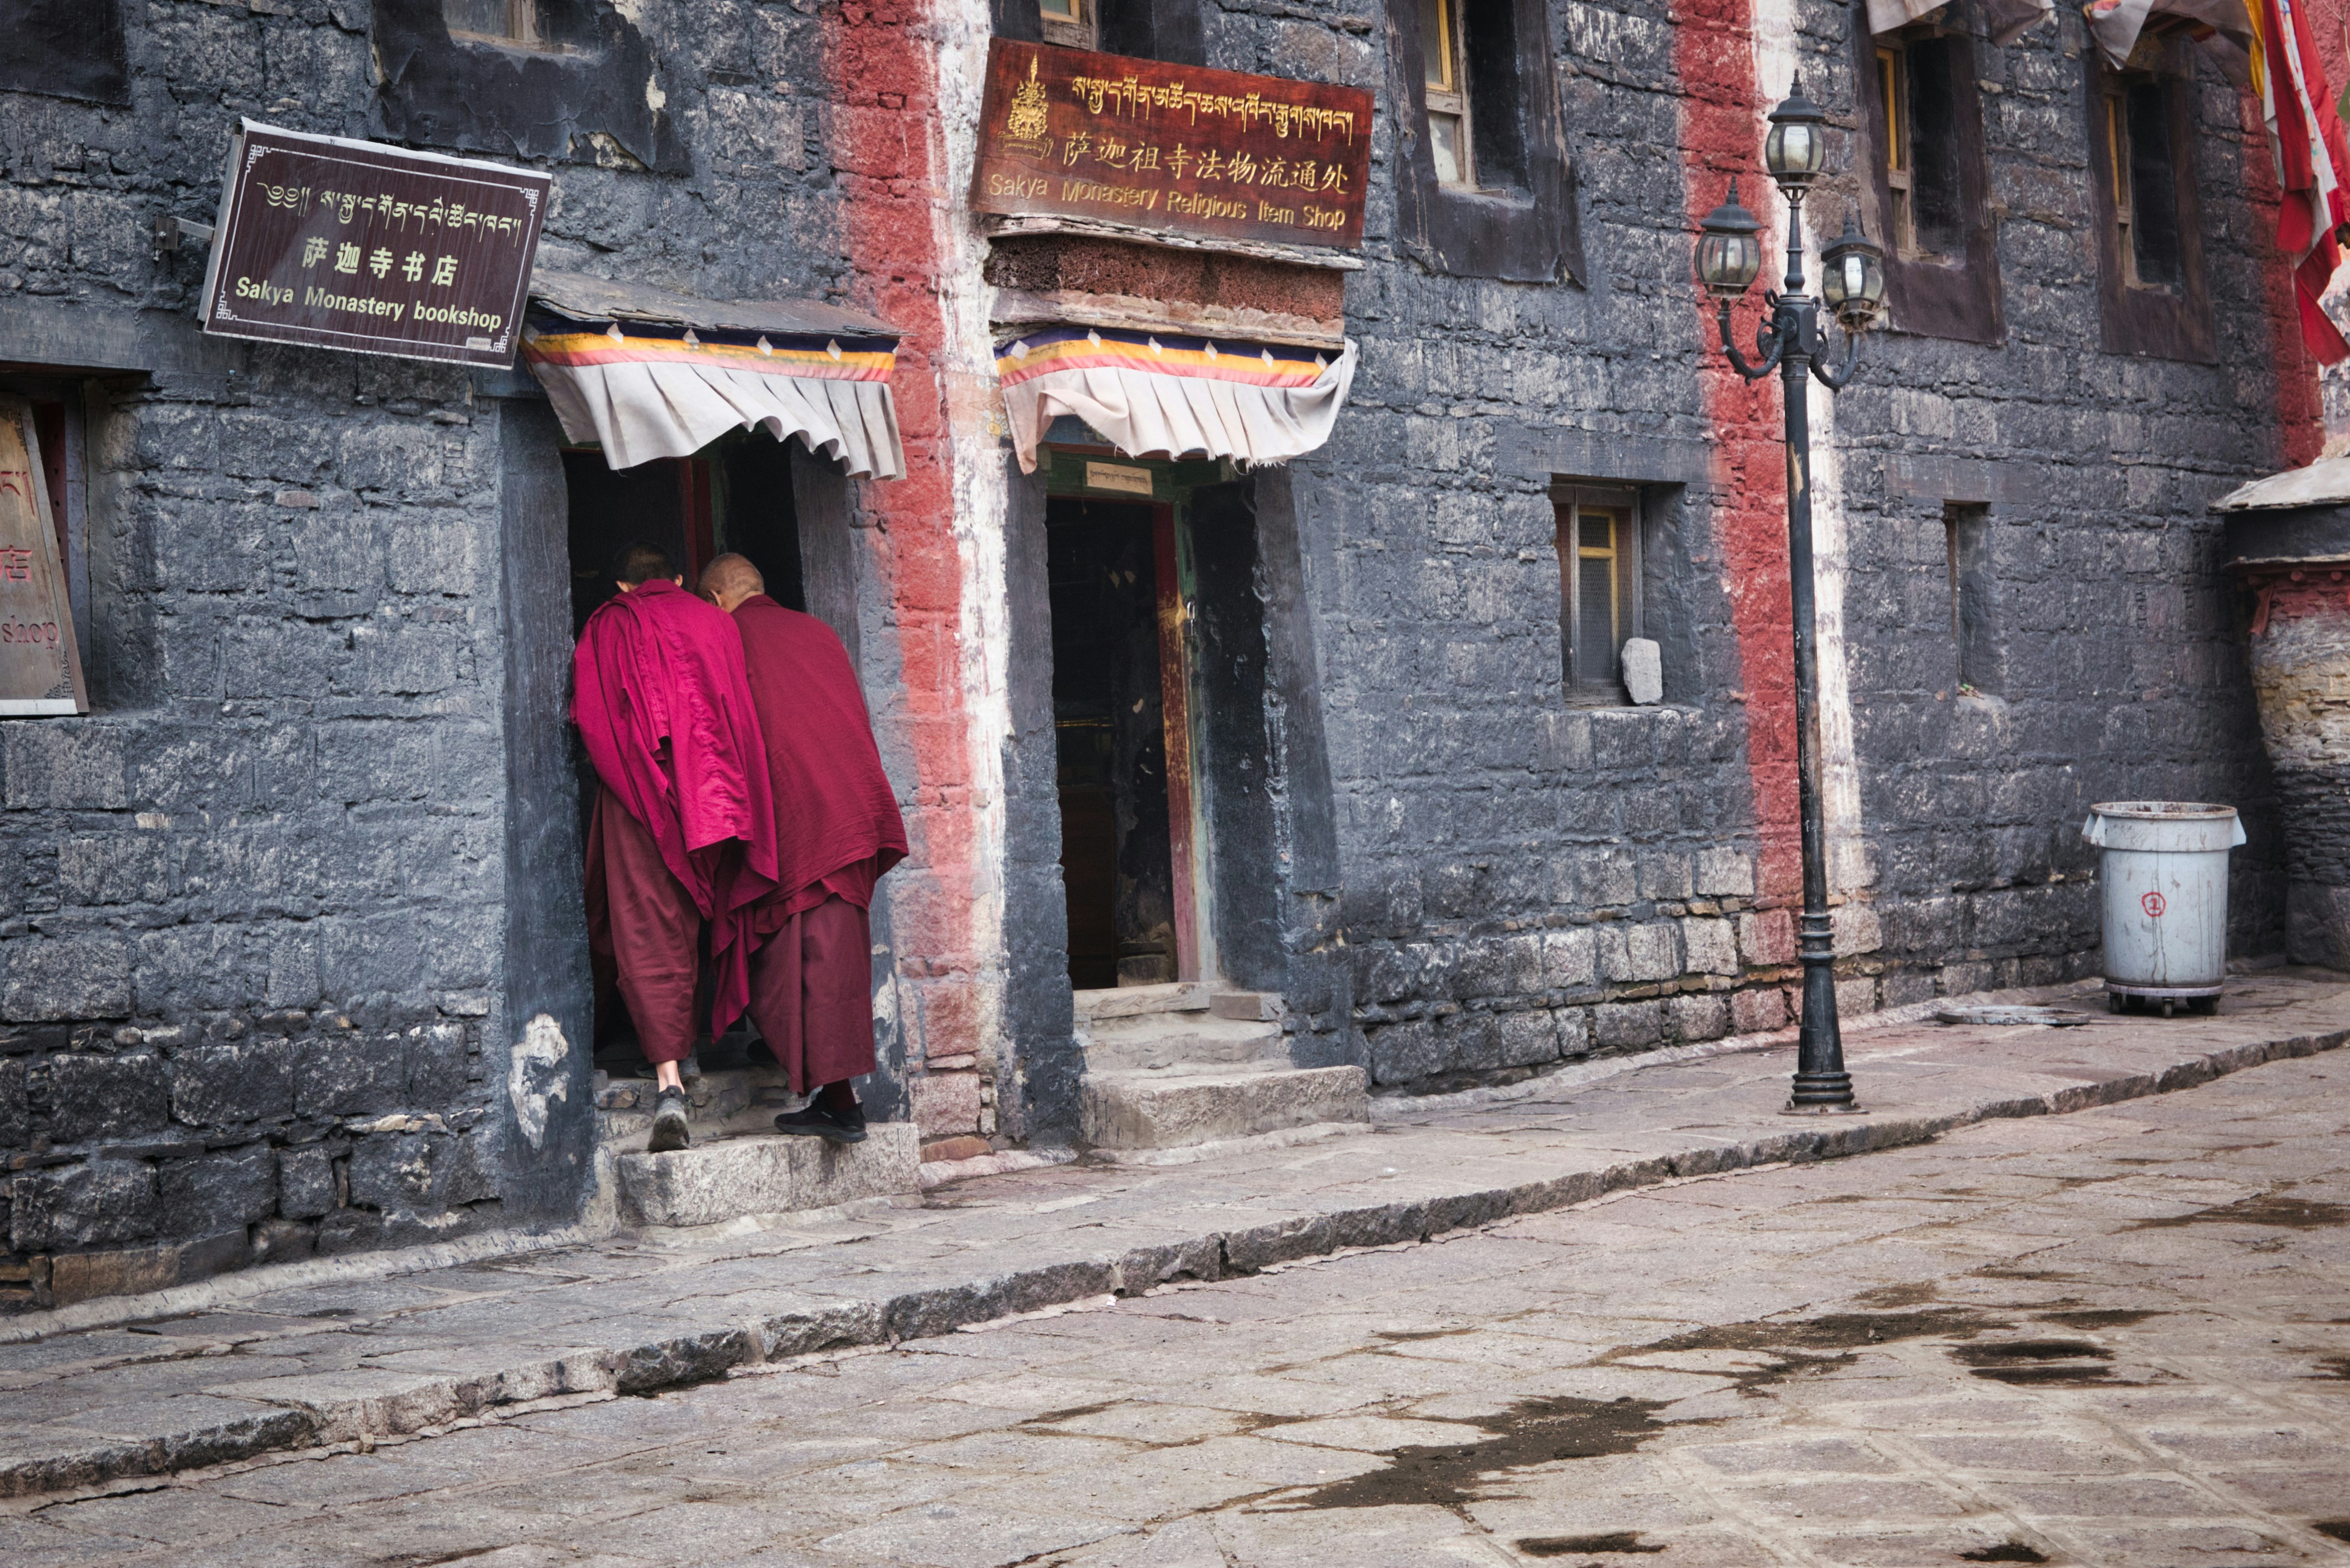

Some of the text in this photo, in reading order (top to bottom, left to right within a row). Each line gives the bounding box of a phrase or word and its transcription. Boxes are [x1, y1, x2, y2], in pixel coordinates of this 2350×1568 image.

[1063, 131, 1349, 194] 萨迦祖寺法物流通处
[989, 174, 1346, 230] Sakya Monastery Religious Item Shop
[302, 236, 458, 286] 萨迦寺书店
[236, 277, 501, 333] Sakya Monastery bookshop
